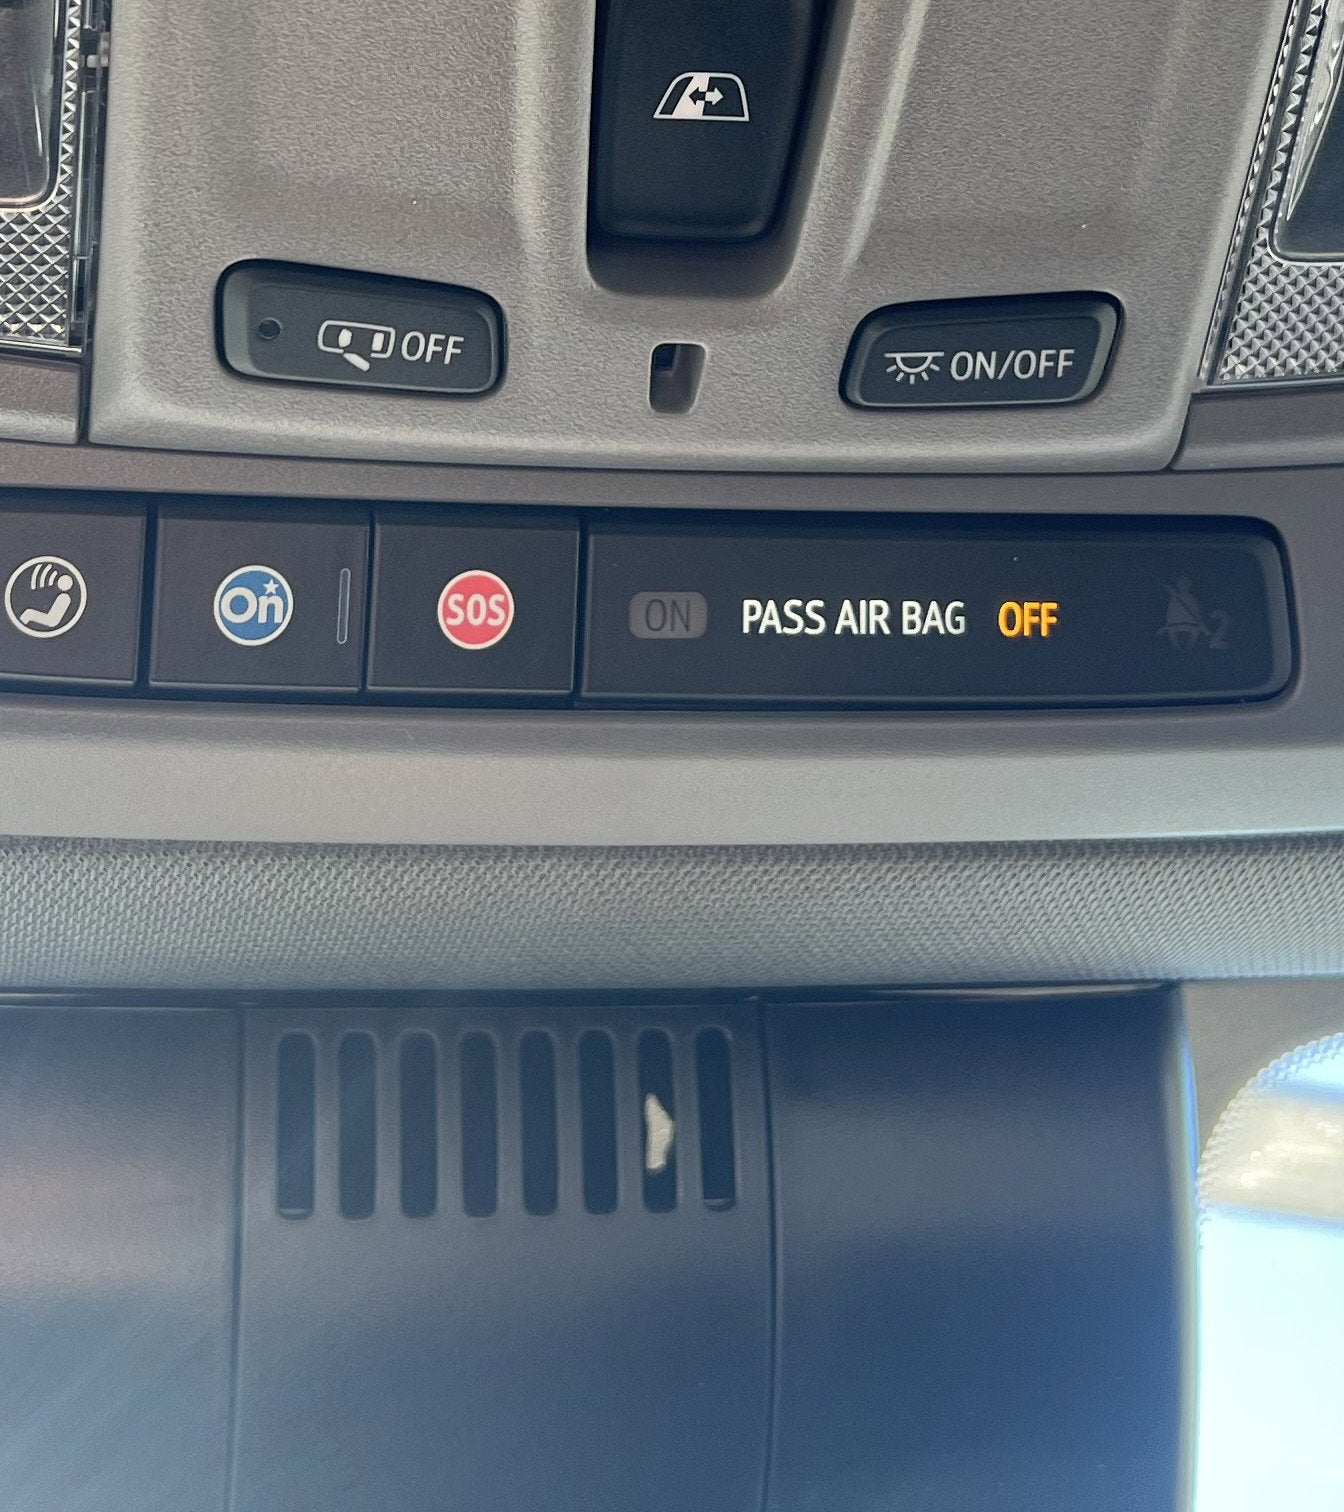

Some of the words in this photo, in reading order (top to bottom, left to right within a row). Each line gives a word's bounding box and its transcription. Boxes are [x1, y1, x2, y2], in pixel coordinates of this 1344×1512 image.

[400, 330, 466, 366] OFF
[949, 348, 1076, 382] ON/OFF
[221, 586, 284, 624] On
[446, 592, 506, 627] SOS
[644, 597, 692, 633] ON
[741, 598, 826, 636] PASS
[833, 598, 892, 636] AIR
[901, 599, 967, 636] BAG
[997, 600, 1059, 638] OFF
